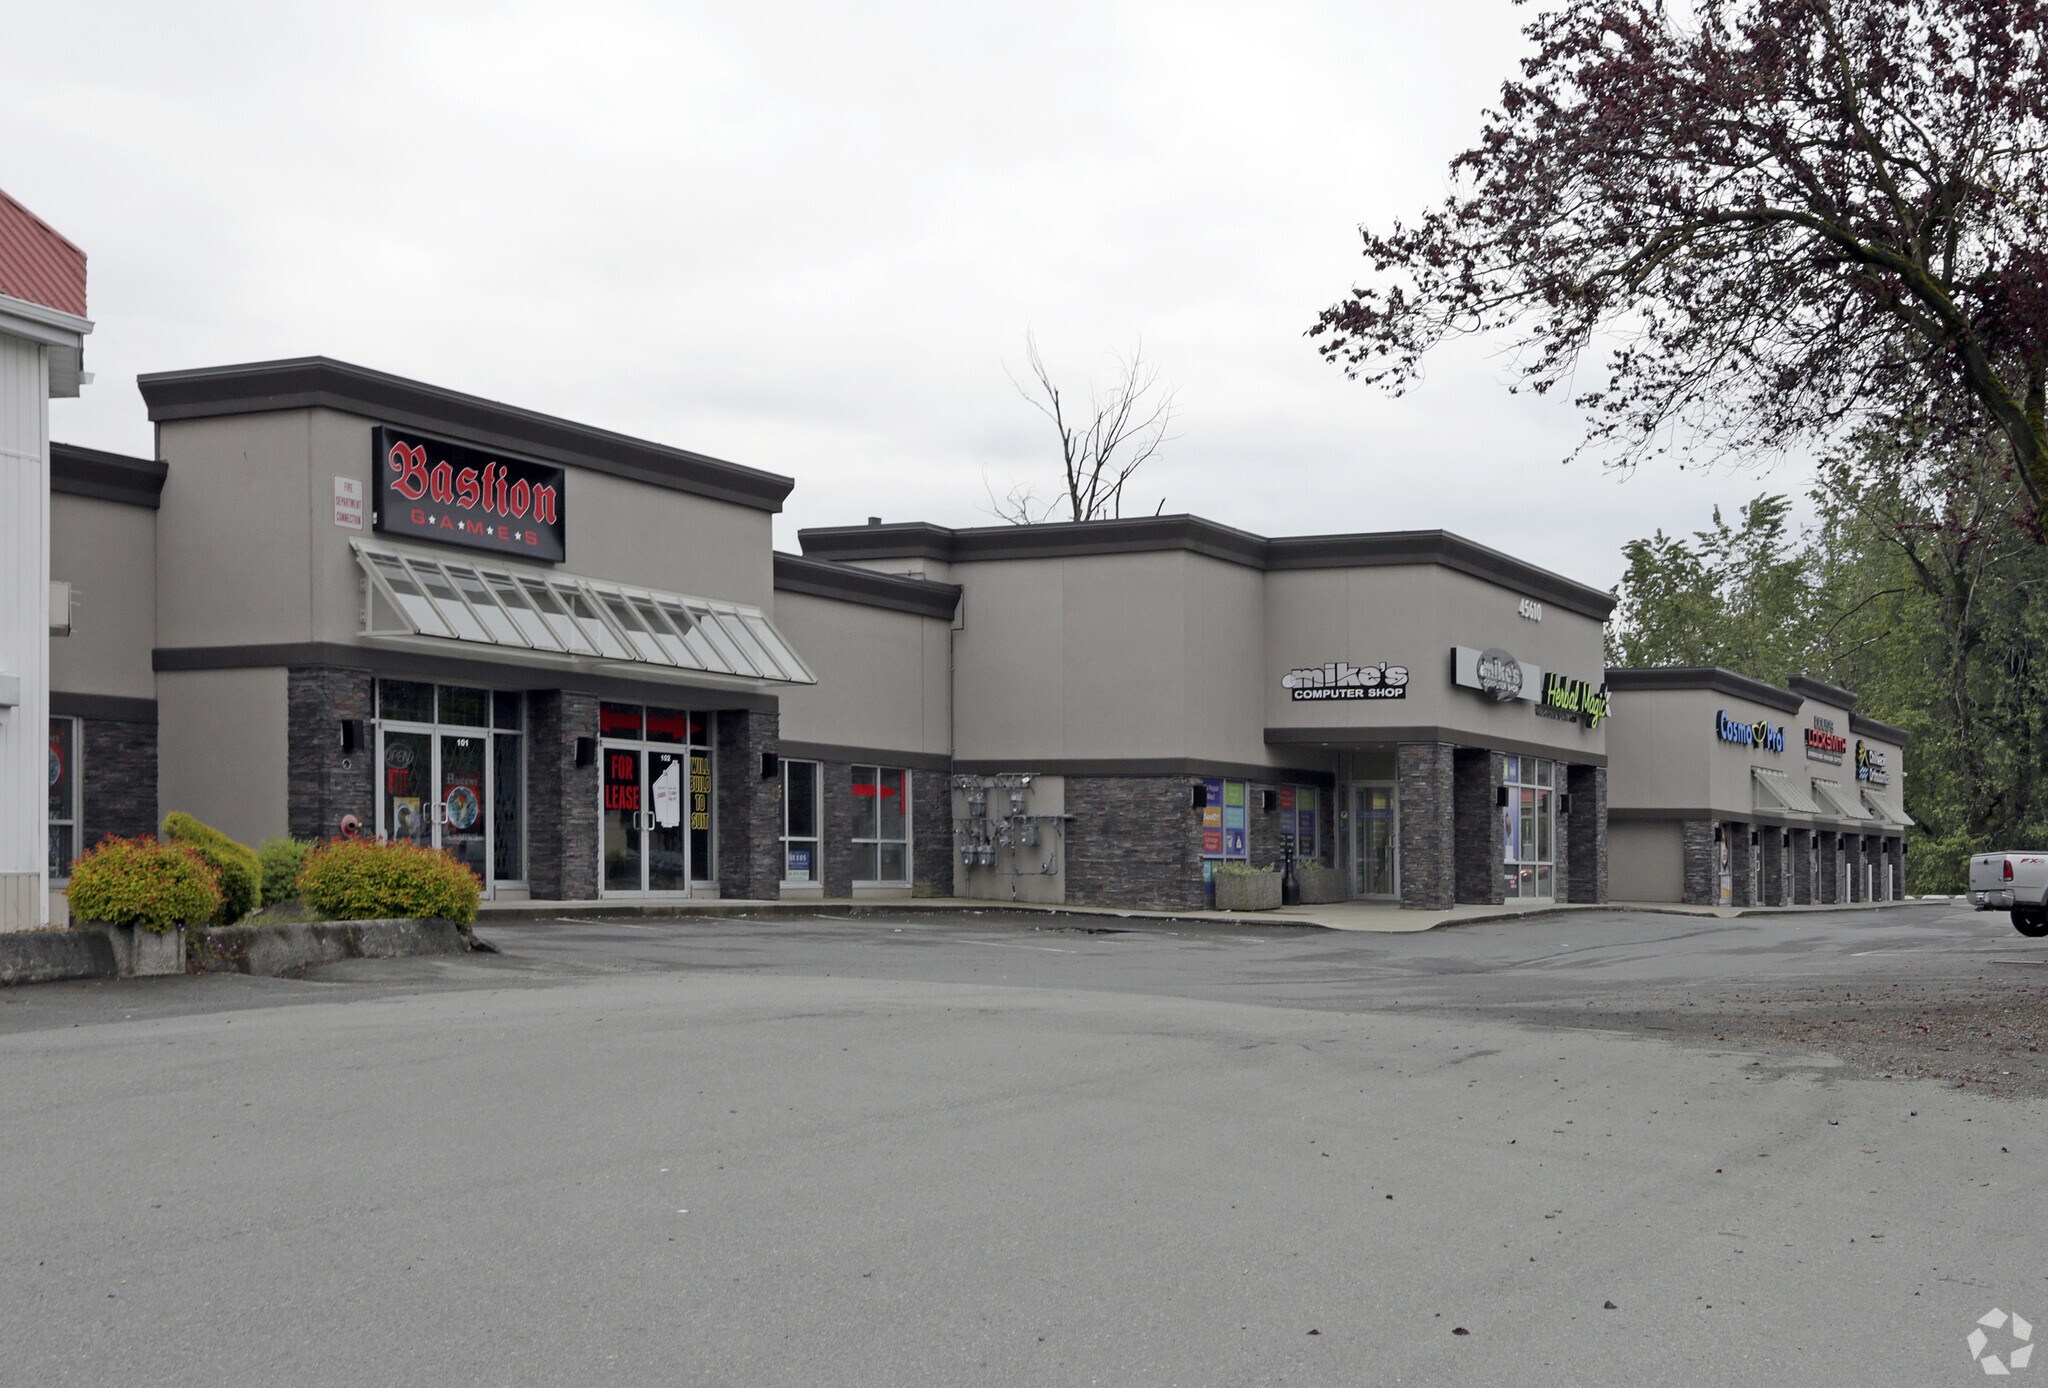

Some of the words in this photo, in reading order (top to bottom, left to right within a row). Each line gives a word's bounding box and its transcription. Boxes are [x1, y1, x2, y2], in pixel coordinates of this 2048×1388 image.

[388, 440, 558, 525] Bastion
[1519, 598, 1541, 621] 45610
[1281, 661, 1409, 689] mike's
[1294, 688, 1364, 699] COMPUTER
[1368, 687, 1403, 698] SHOP
[1547, 672, 1579, 712] Herbal
[1581, 682, 1606, 729] Magic
[1720, 709, 1753, 745] Cosmo
[457, 738, 469, 747] 101
[1808, 728, 1846, 753] LOCKSMITH
[612, 754, 633, 780] FOR
[661, 754, 671, 762] 102
[690, 756, 710, 775] WILL
[605, 785, 639, 811] LEASE
[695, 794, 705, 811] TO
[691, 812, 709, 830] SUIT
